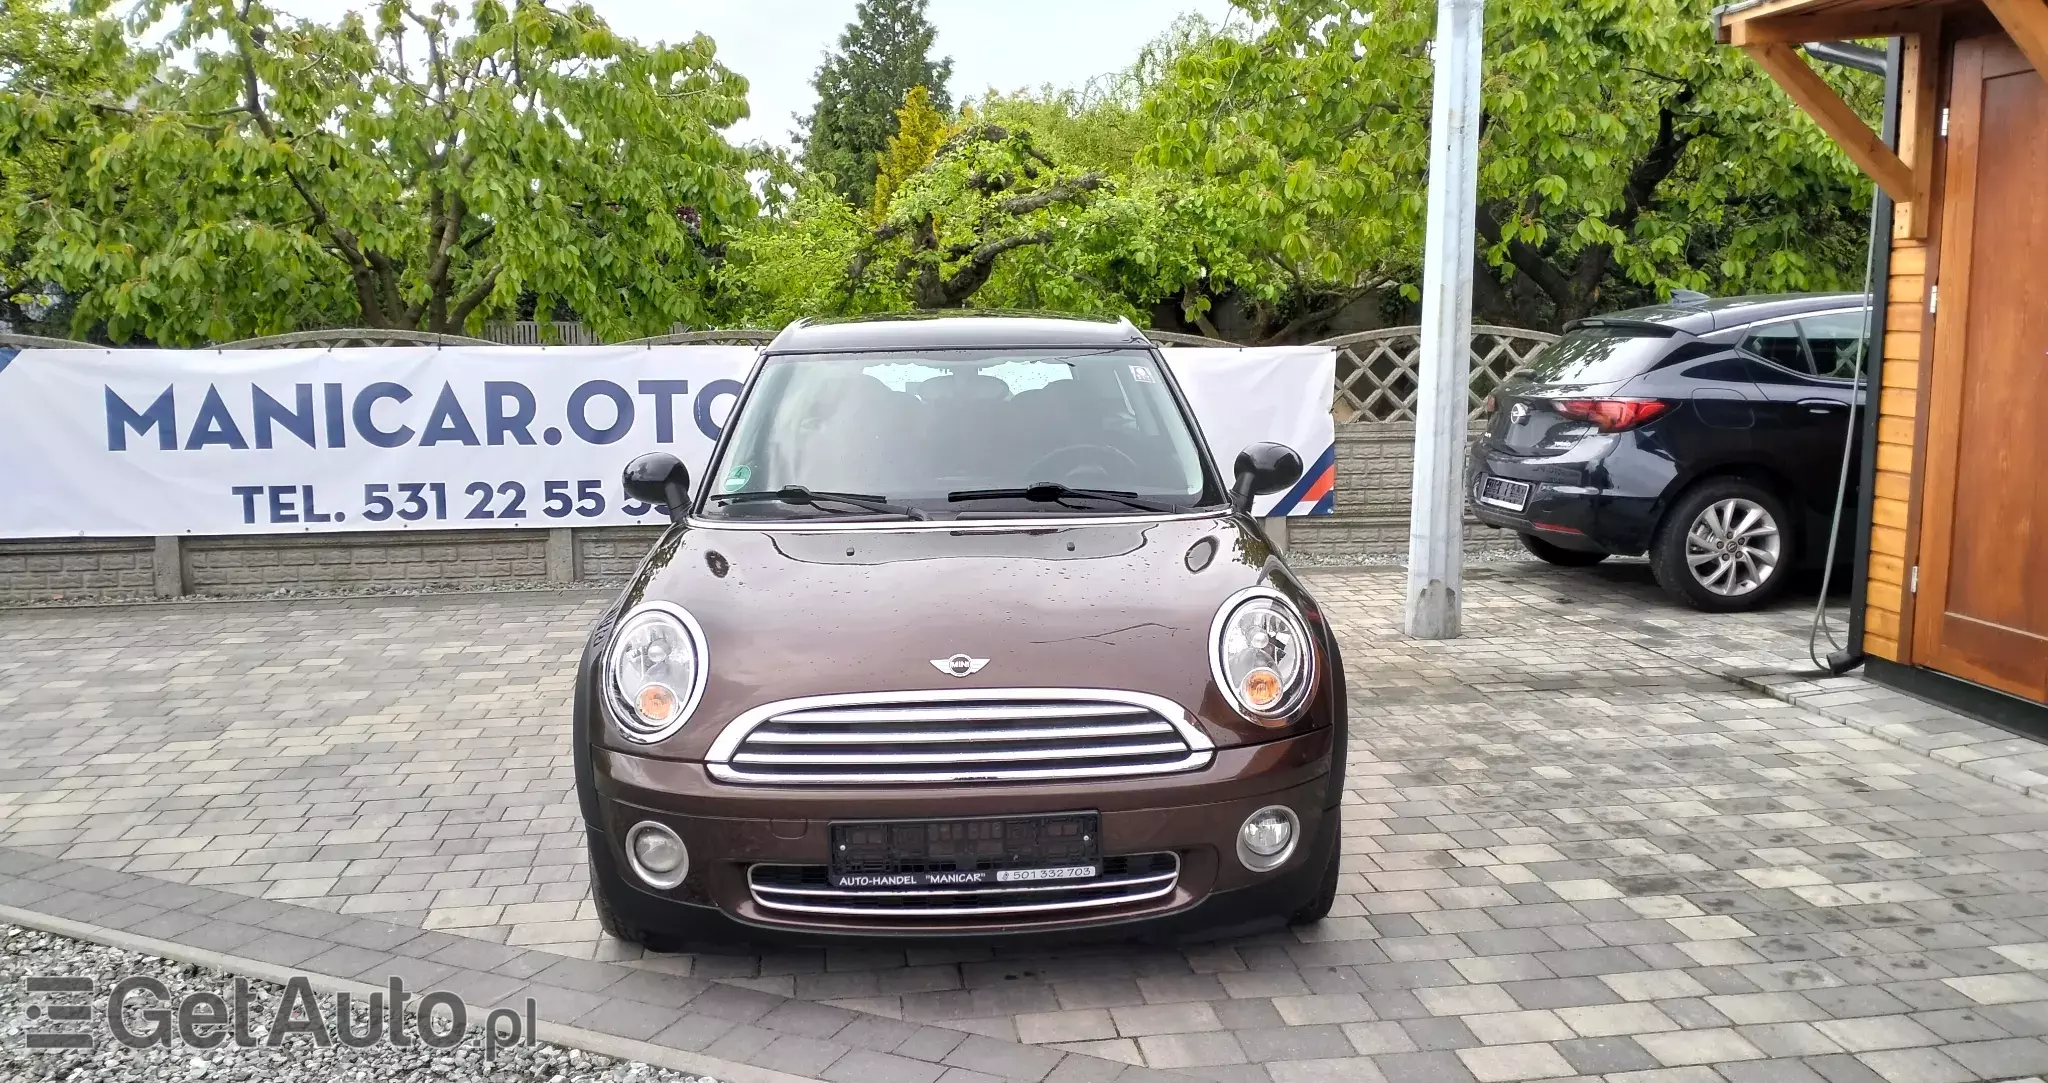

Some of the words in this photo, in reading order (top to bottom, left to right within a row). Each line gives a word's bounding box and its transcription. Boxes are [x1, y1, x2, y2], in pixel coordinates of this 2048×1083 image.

[231, 484, 346, 524] TEL.
[362, 482, 447, 521] 531
[464, 480, 527, 519] 22
[542, 479, 606, 518] 55
[950, 660, 970, 668] MINI
[839, 875, 917, 886] AUTO-HANDEL
[925, 872, 986, 884] "MANICAR"
[1013, 871, 1036, 880] 501
[1040, 869, 1064, 879] 332
[1067, 867, 1091, 877] 703
